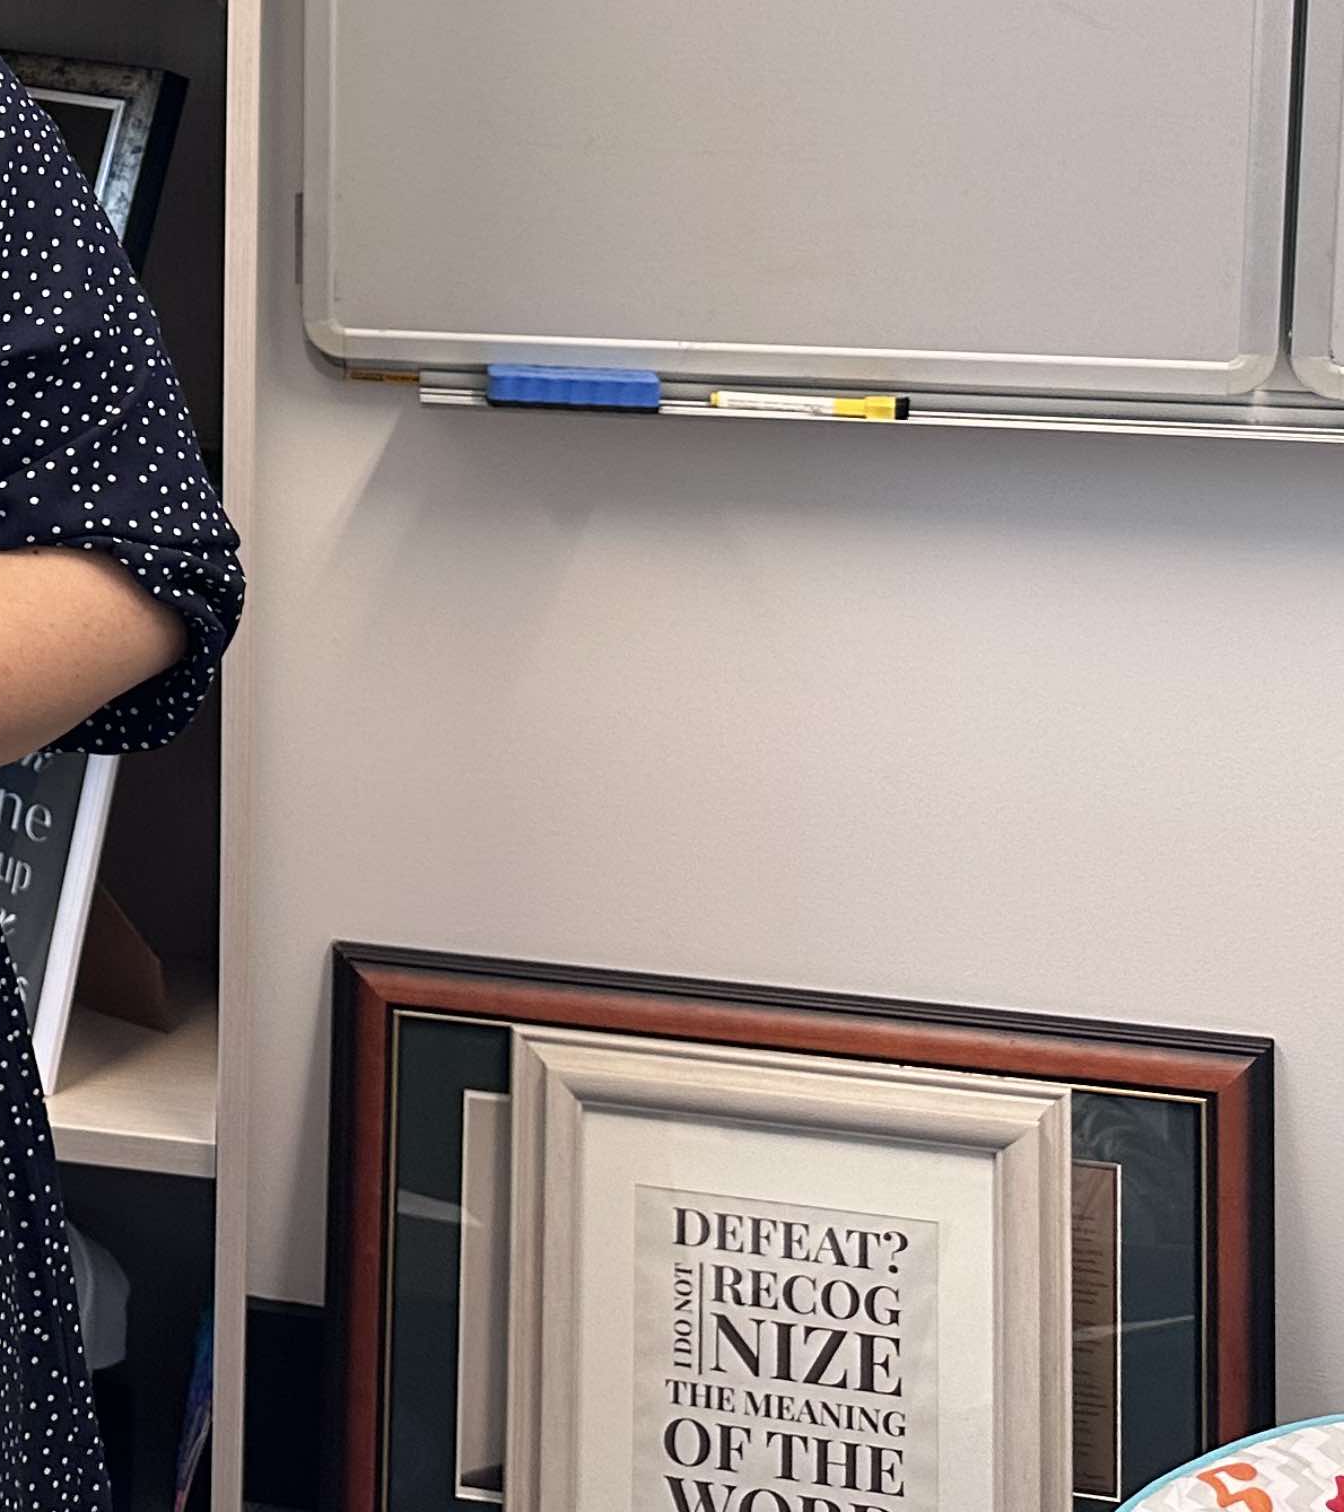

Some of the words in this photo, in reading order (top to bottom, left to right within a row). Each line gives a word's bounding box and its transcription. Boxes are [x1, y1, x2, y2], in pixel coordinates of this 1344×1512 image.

[673, 1206, 909, 1274] DEFEAT?
[673, 1262, 693, 1313] NOT
[711, 1263, 903, 1327] RECOG
[673, 1319, 692, 1356] DO
[673, 1359, 692, 1369] I
[710, 1311, 903, 1398] NIZE
[665, 1378, 736, 1413] THE
[743, 1390, 907, 1438] MEANING
[663, 1417, 752, 1473] OF
[766, 1431, 905, 1498] THE
